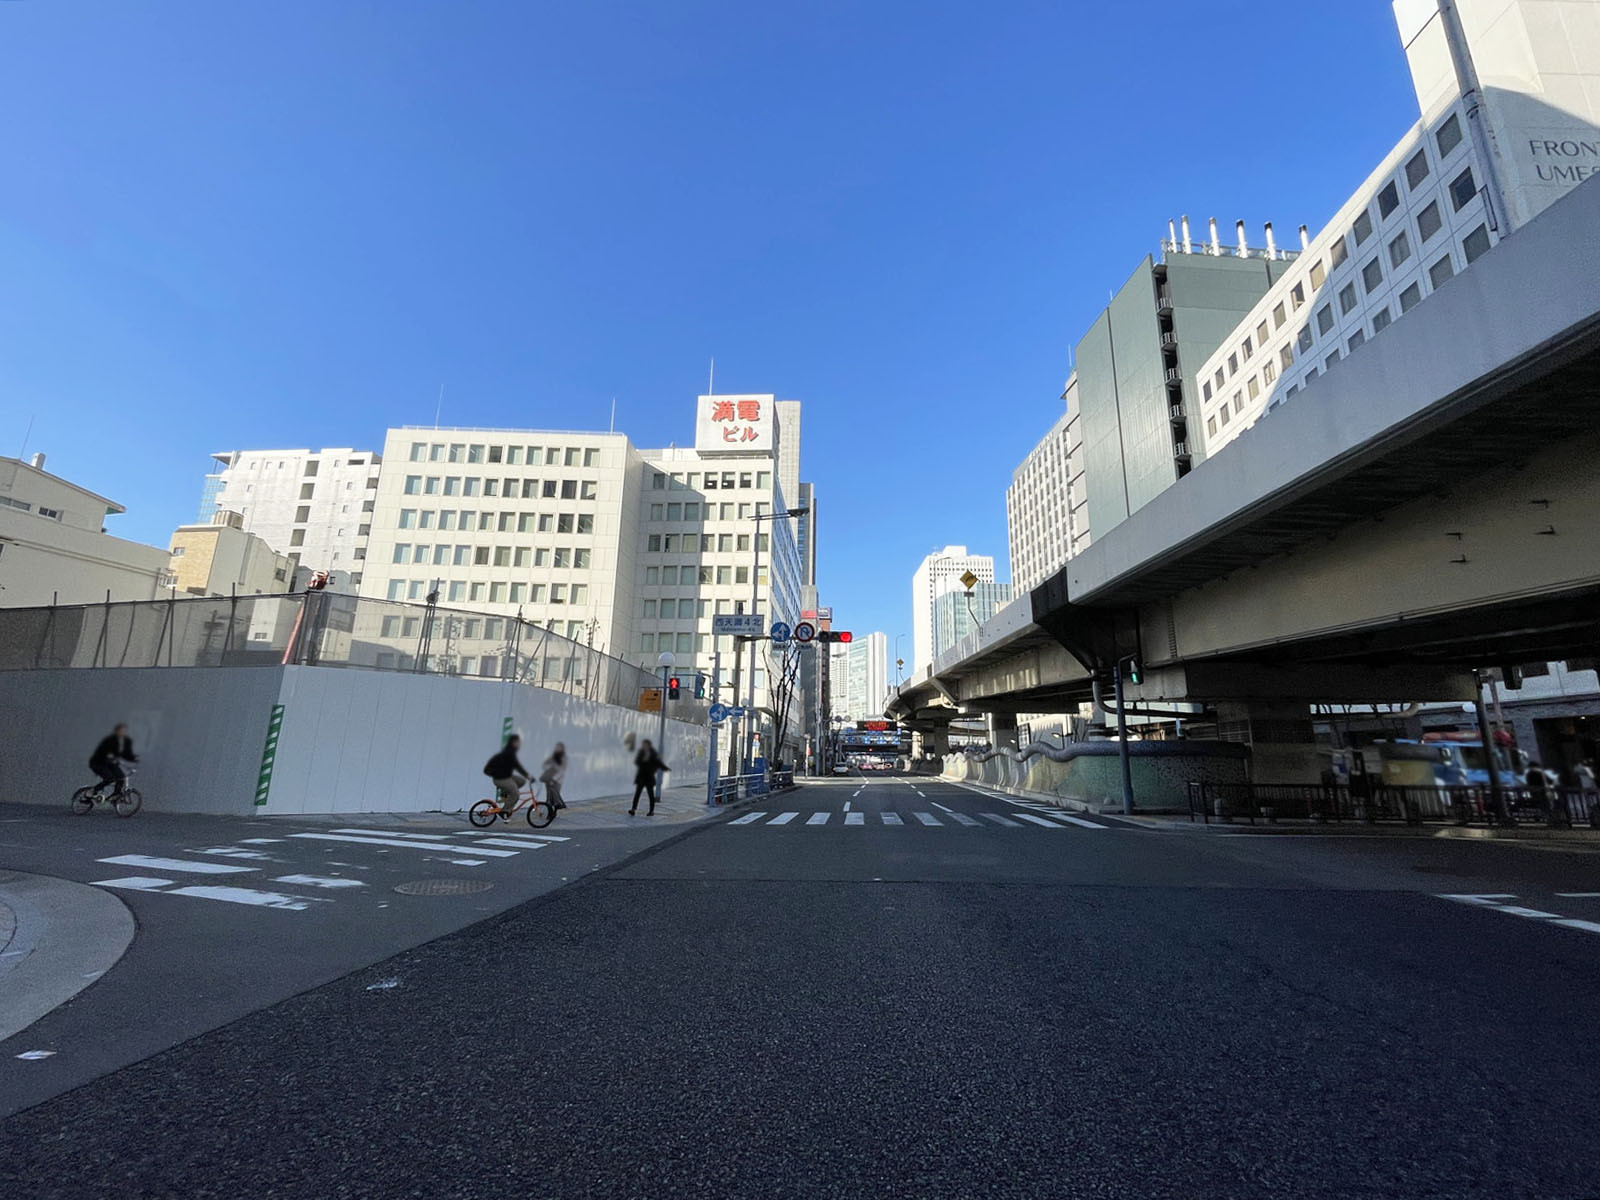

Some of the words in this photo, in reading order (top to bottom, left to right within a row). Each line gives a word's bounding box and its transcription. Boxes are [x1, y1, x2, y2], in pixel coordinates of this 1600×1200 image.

[1529, 139, 1600, 156] FRON
[712, 400, 760, 422] 満電
[723, 426, 759, 442] ビル
